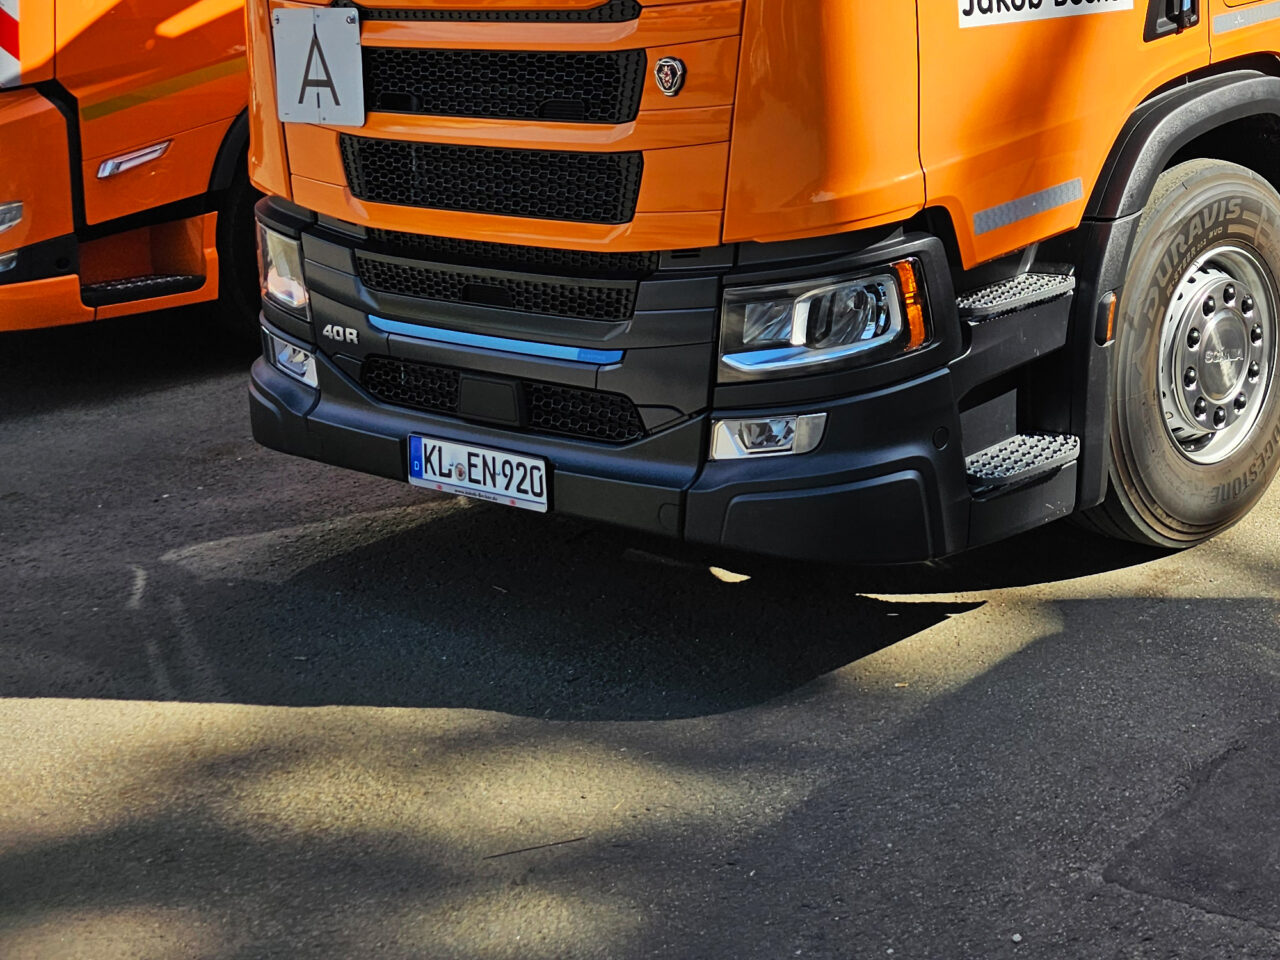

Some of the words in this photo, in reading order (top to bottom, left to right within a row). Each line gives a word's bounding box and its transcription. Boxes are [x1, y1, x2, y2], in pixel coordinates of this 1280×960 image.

[298, 22, 342, 107] A
[1143, 198, 1242, 324] DURAVIS
[414, 460, 420, 471] D
[423, 443, 453, 479] KL
